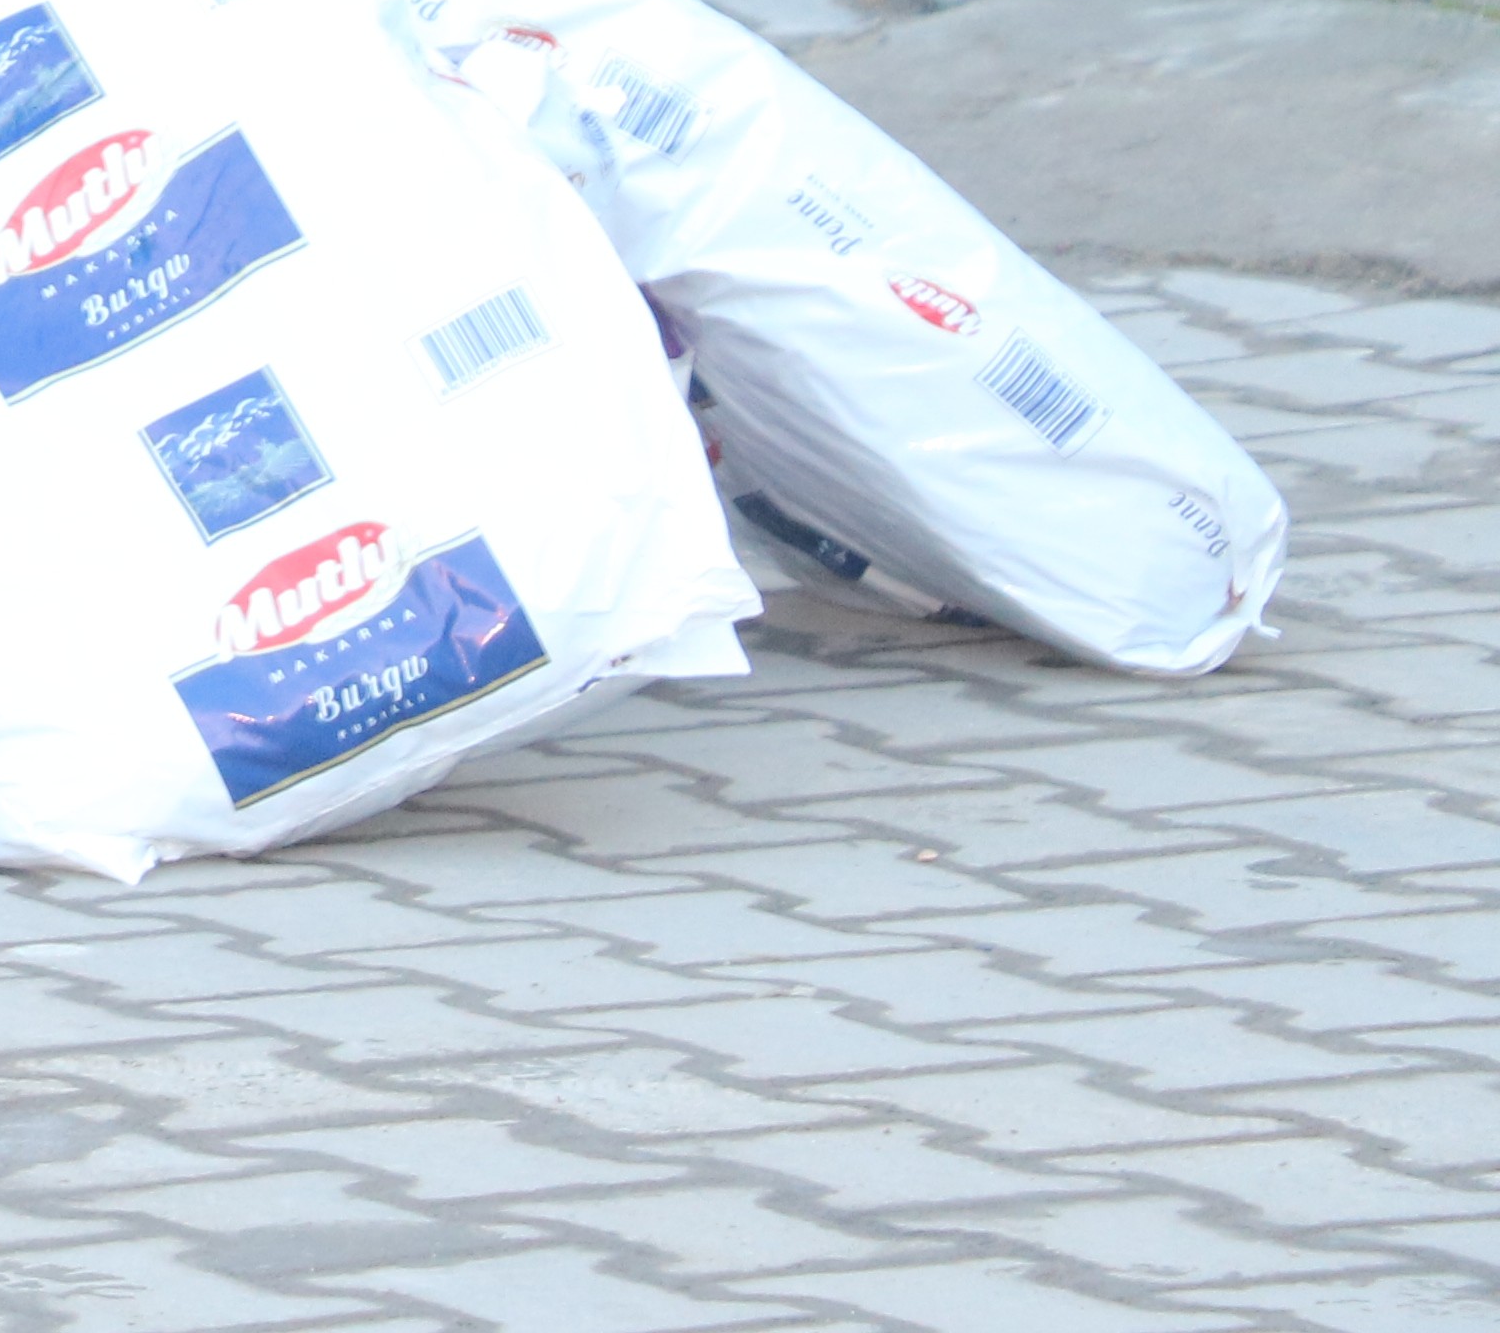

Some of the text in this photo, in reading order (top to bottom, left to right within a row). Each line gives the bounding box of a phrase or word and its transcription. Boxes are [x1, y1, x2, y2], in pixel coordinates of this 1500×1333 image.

[787, 190, 863, 256] Penne
[80, 252, 191, 328] Burgu
[215, 525, 403, 664] Mutlu
[268, 608, 417, 685] MAKARNA
[313, 655, 429, 722] Burgu
